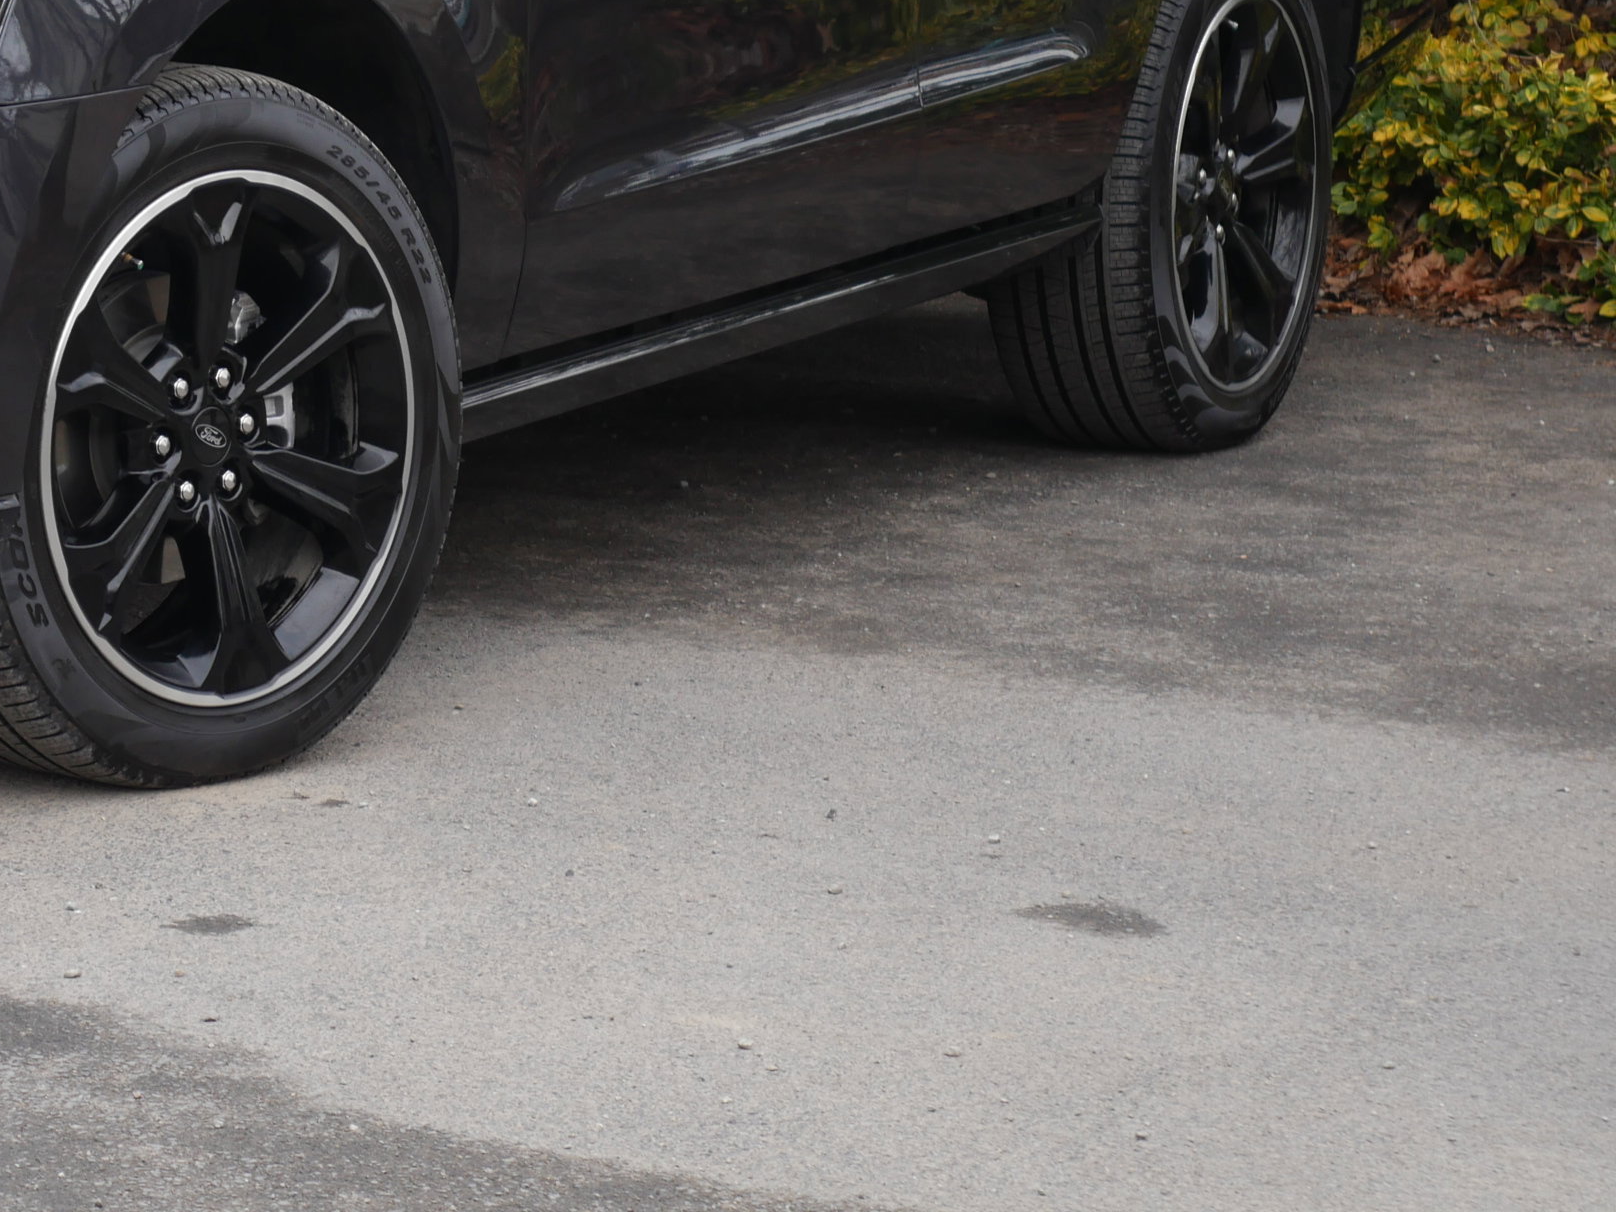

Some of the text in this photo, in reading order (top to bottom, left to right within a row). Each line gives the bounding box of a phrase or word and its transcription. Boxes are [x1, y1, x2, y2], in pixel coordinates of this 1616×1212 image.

[325, 144, 403, 221] 285/45
[400, 227, 432, 285] R22
[200, 427, 222, 445] Ford
